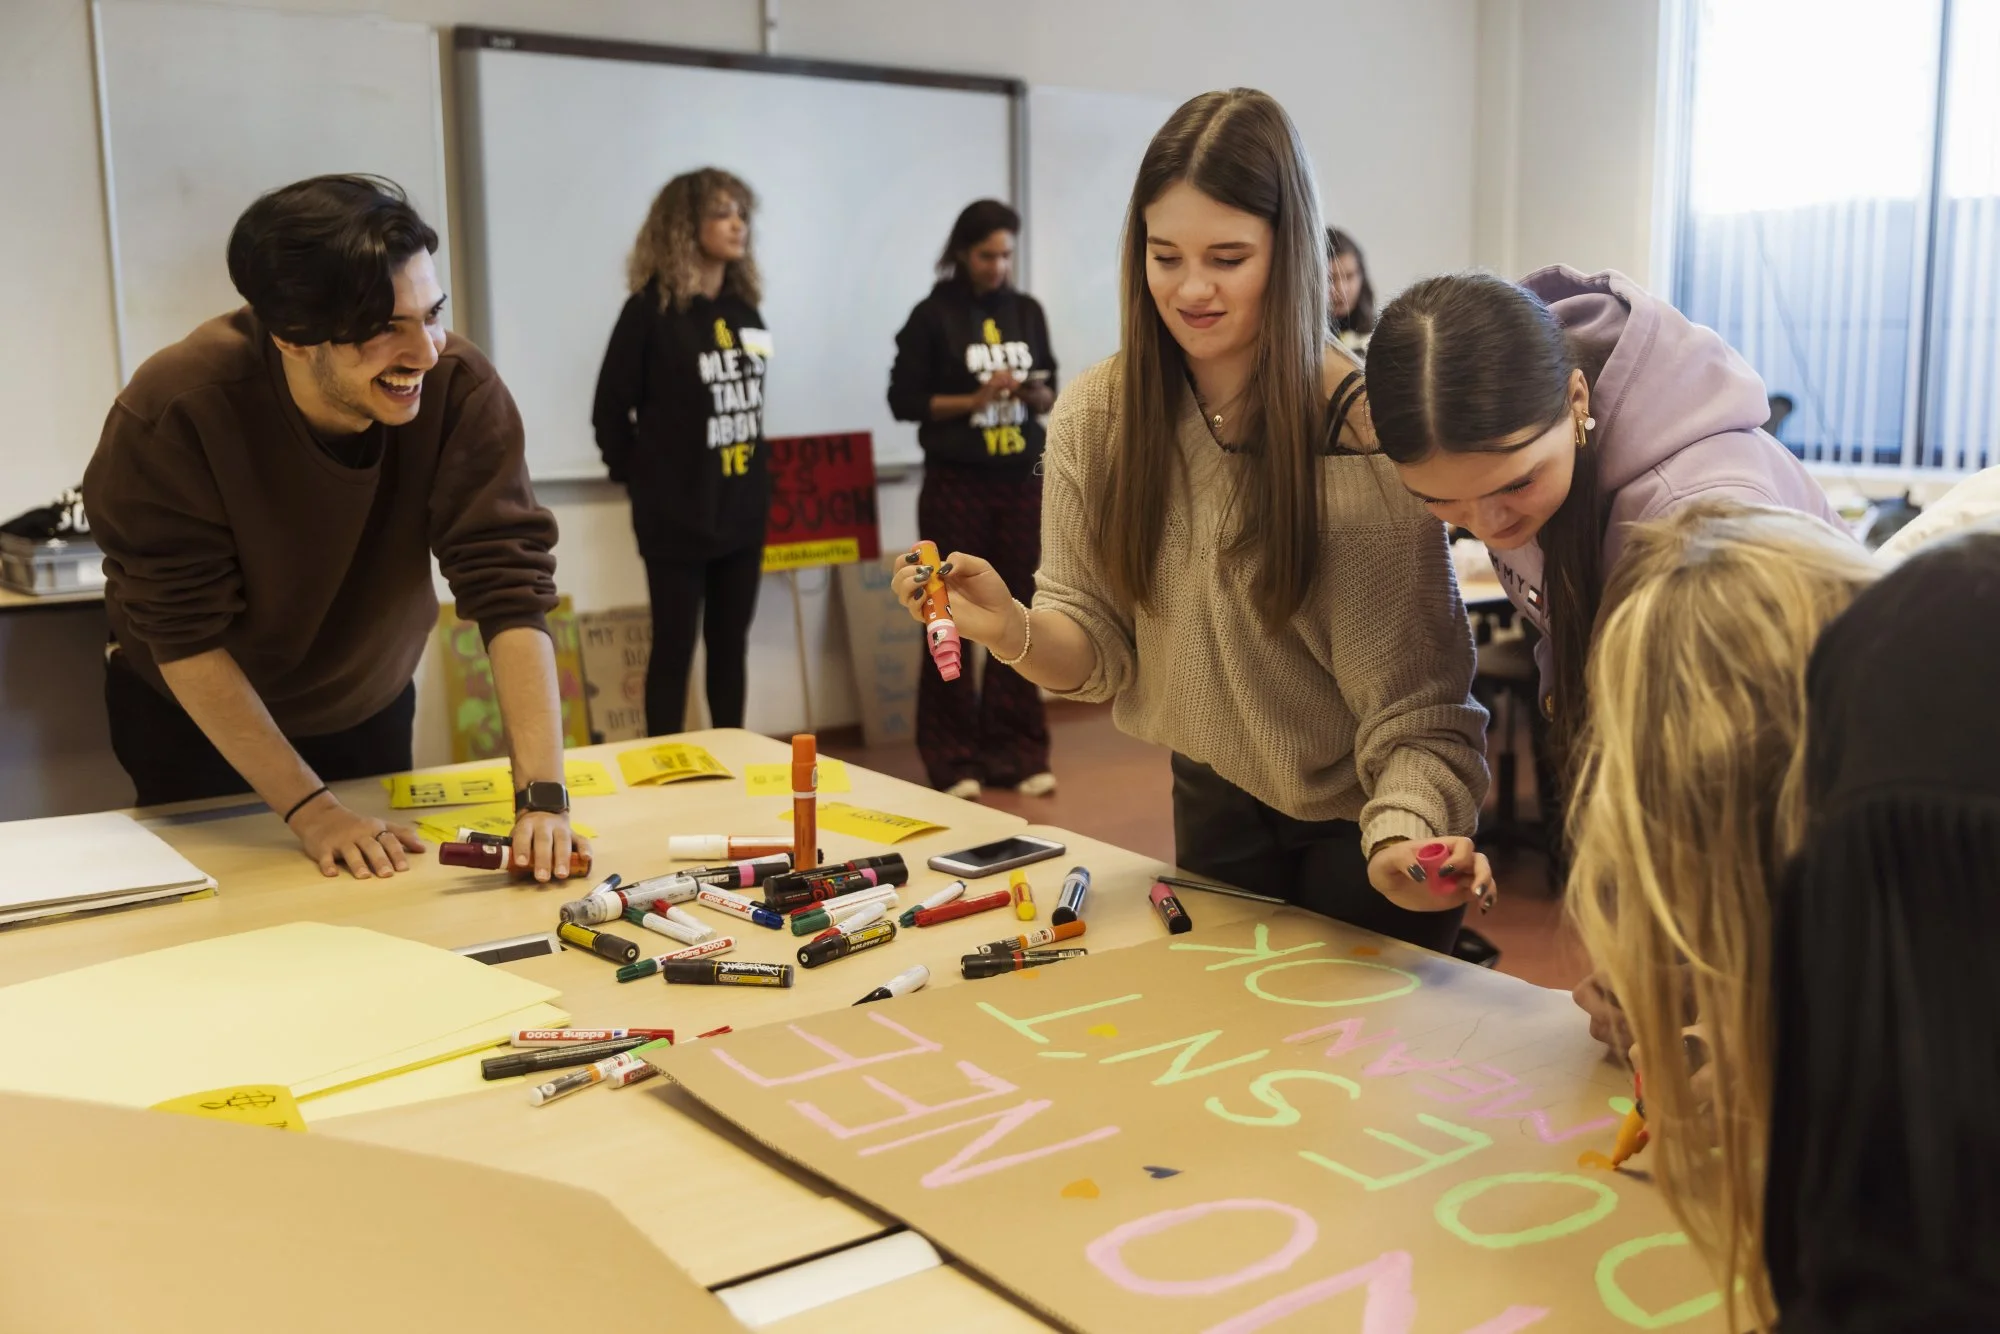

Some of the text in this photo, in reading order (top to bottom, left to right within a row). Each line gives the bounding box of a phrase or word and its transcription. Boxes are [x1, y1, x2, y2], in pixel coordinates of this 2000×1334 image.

[709, 378, 764, 414] TALK
[706, 411, 764, 449] ABOU
[982, 425, 1027, 456] YES
[720, 443, 756, 477] YE
[768, 486, 877, 533] OUGH
[1486, 553, 1525, 588] MMY
[587, 626, 615, 646] MY
[701, 939, 726, 954] 3000
[1168, 923, 1422, 1008] OK
[526, 1030, 606, 1041] edding 3000
[1282, 1017, 1617, 1144] MEAN
[711, 1010, 1121, 1189] NEE
